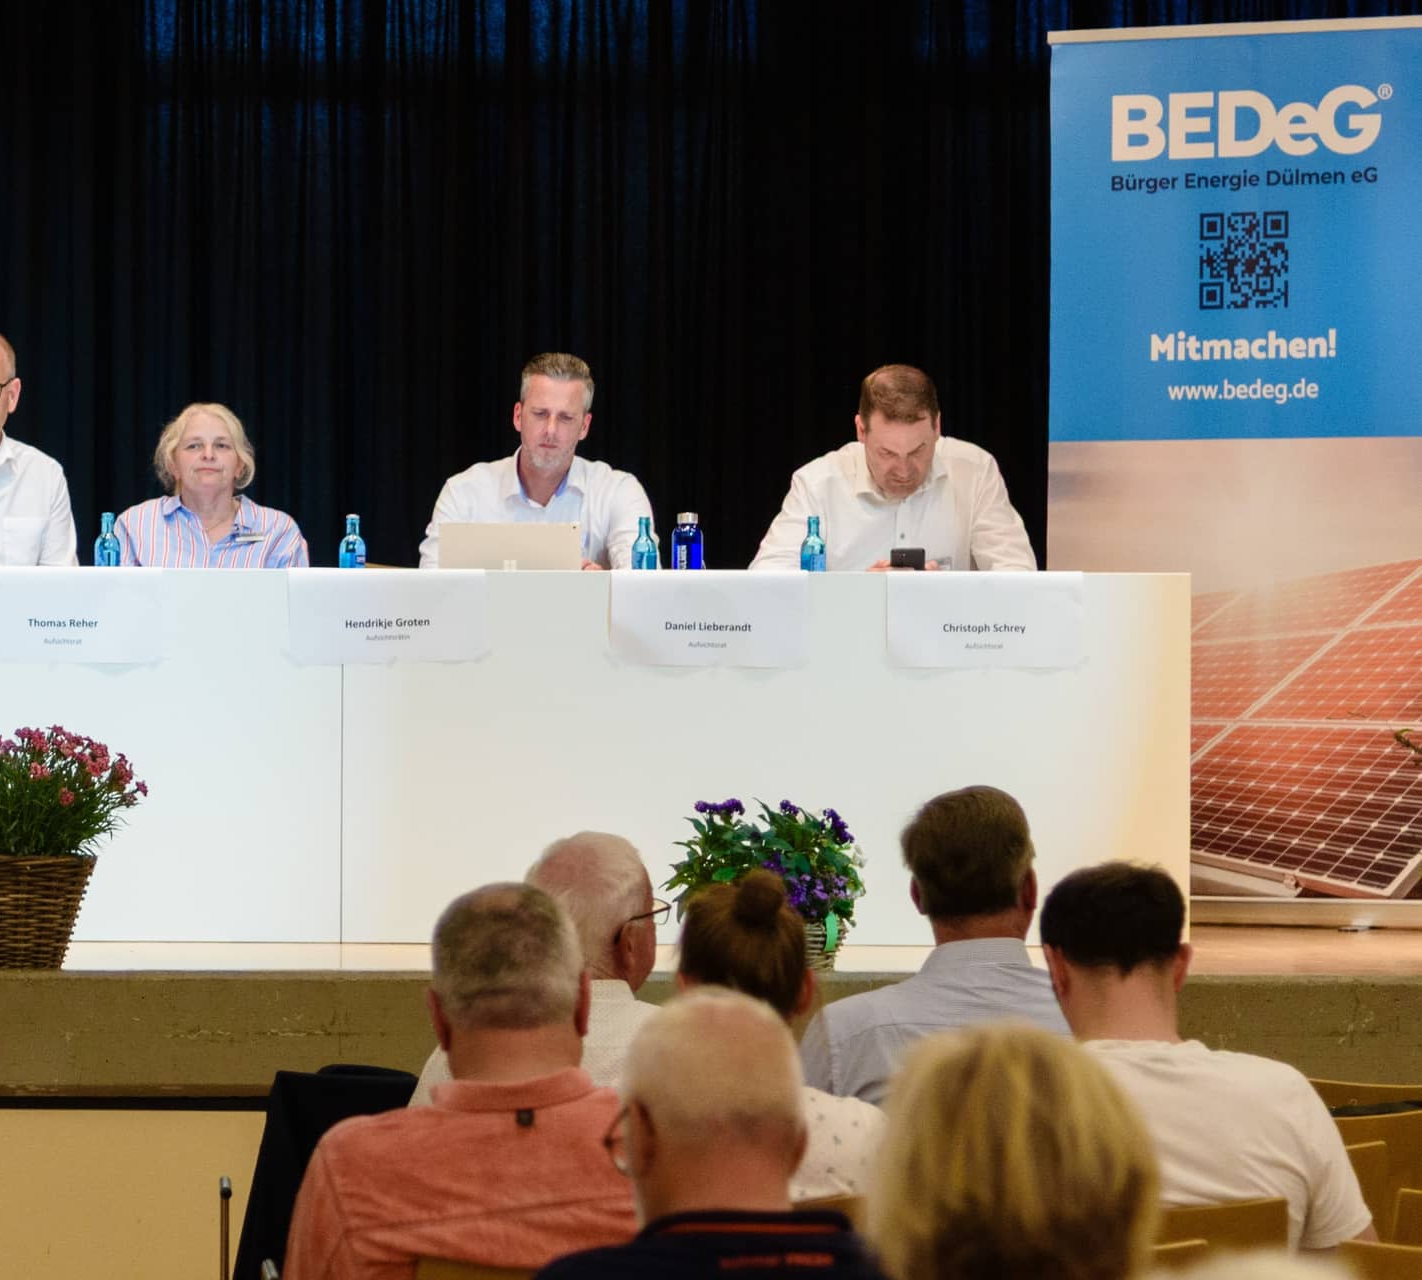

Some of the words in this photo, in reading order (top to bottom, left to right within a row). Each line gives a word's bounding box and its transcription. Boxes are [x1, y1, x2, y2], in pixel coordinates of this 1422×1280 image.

[1110, 173, 1178, 194] Bürger
[1185, 169, 1259, 192] Energie
[1265, 167, 1345, 186] Dülmen
[1351, 166, 1378, 183] eG
[1150, 328, 1337, 361] Mitmachen!
[1168, 377, 1319, 404] www.bedeg.de
[27, 618, 67, 628] Thomas
[69, 618, 99, 628] Reher
[345, 618, 393, 629] Hendrikje
[395, 617, 431, 628] Groten
[665, 621, 697, 631] Daniel
[698, 621, 752, 632] Lieberandt
[942, 623, 991, 634] Christoph
[993, 623, 1026, 634] Schrey
